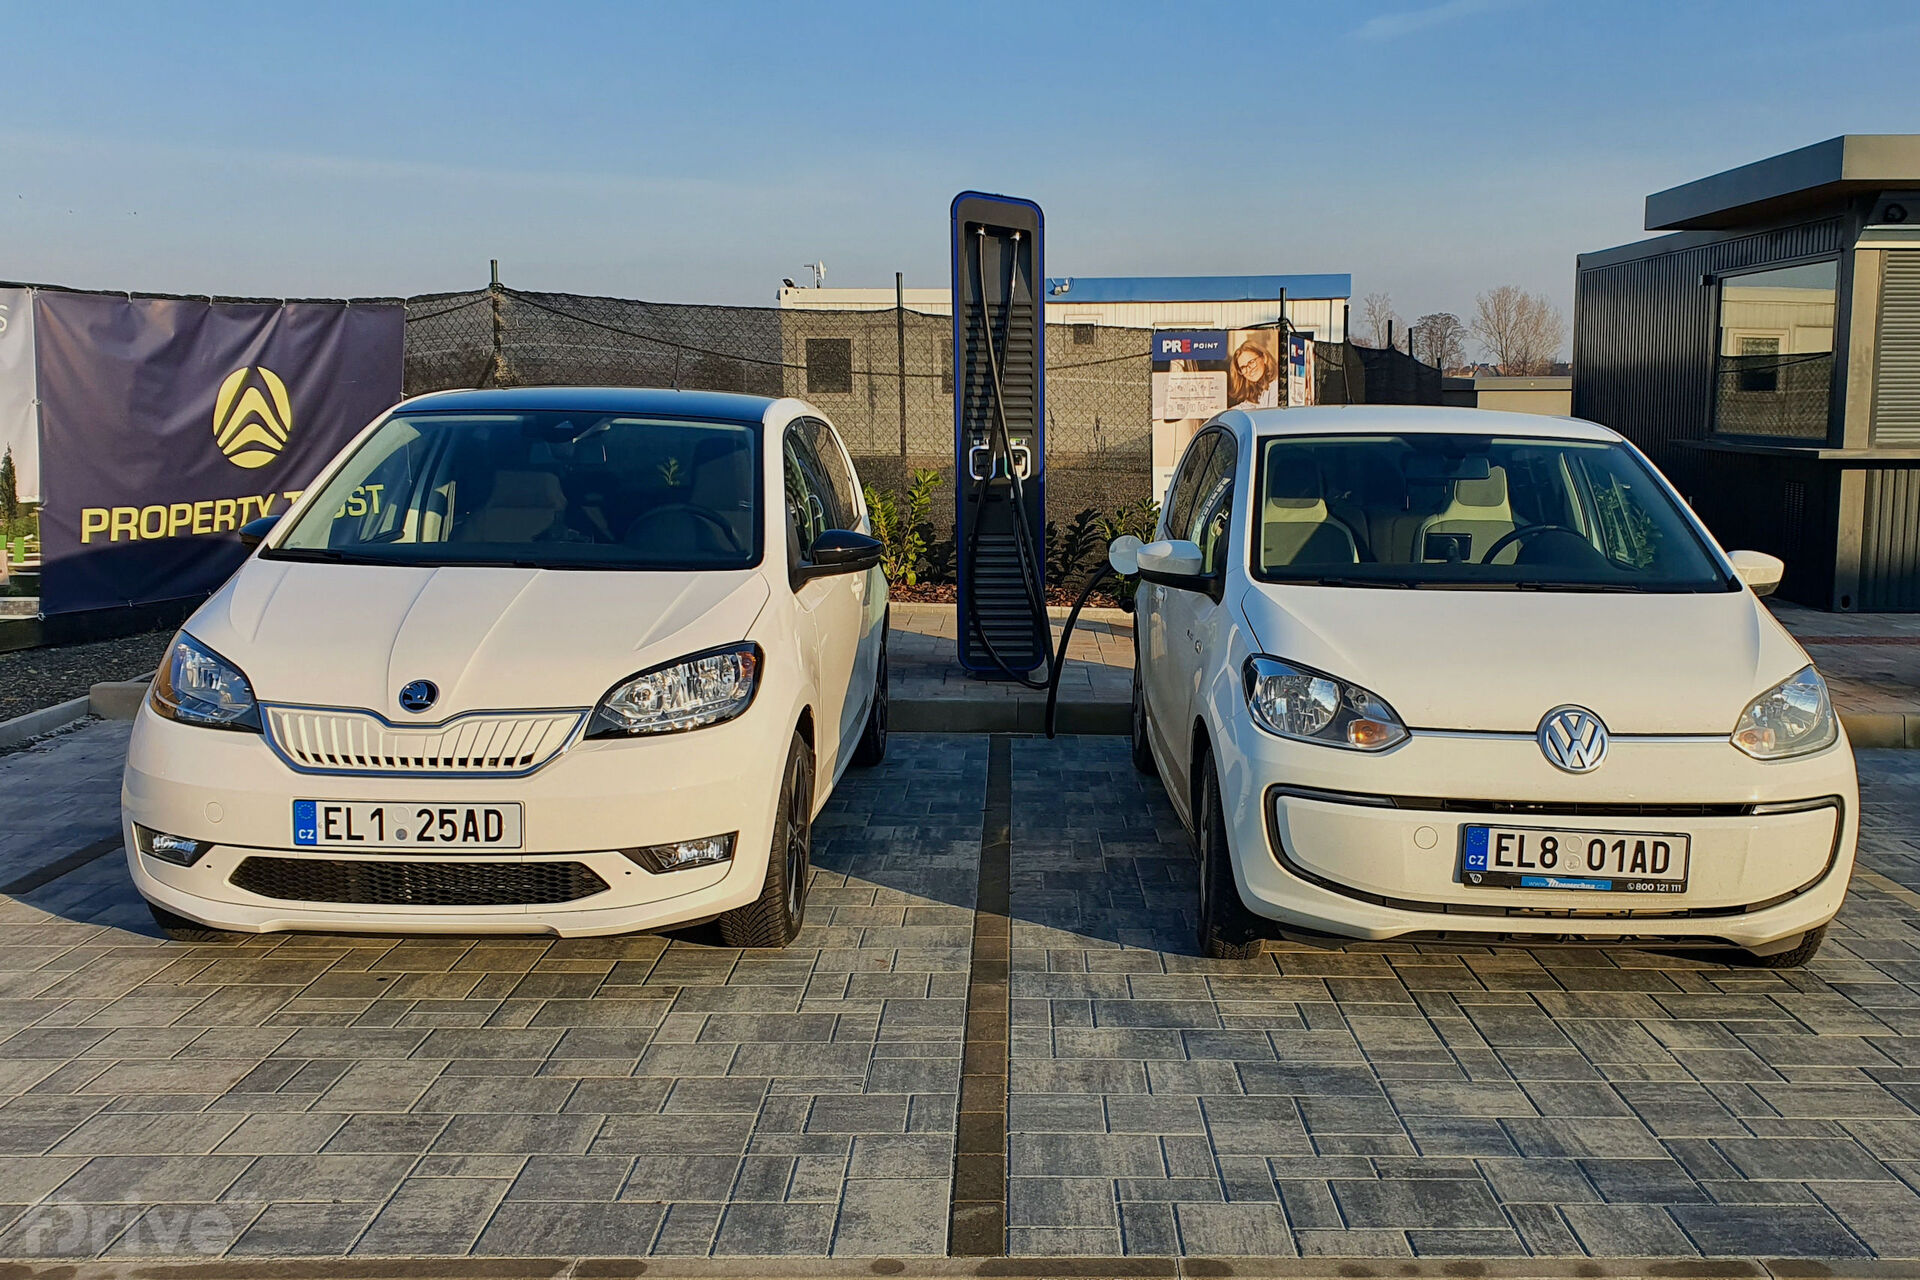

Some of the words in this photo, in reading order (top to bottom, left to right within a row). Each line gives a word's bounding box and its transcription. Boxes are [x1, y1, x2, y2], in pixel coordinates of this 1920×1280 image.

[1162, 339, 1191, 353] PRE
[1193, 342, 1219, 350] POINT
[81, 493, 276, 543] PROPERTY
[283, 484, 385, 519] TST
[324, 806, 385, 841] EL1
[416, 808, 504, 842] 25AD
[298, 829, 315, 839] CZ
[1468, 855, 1485, 865] CZ
[1495, 833, 1559, 869] EL8
[1587, 838, 1671, 874] 01AD
[1635, 882, 1655, 891] 800
[1656, 883, 1669, 892] 121
[1671, 884, 1682, 892] 111
